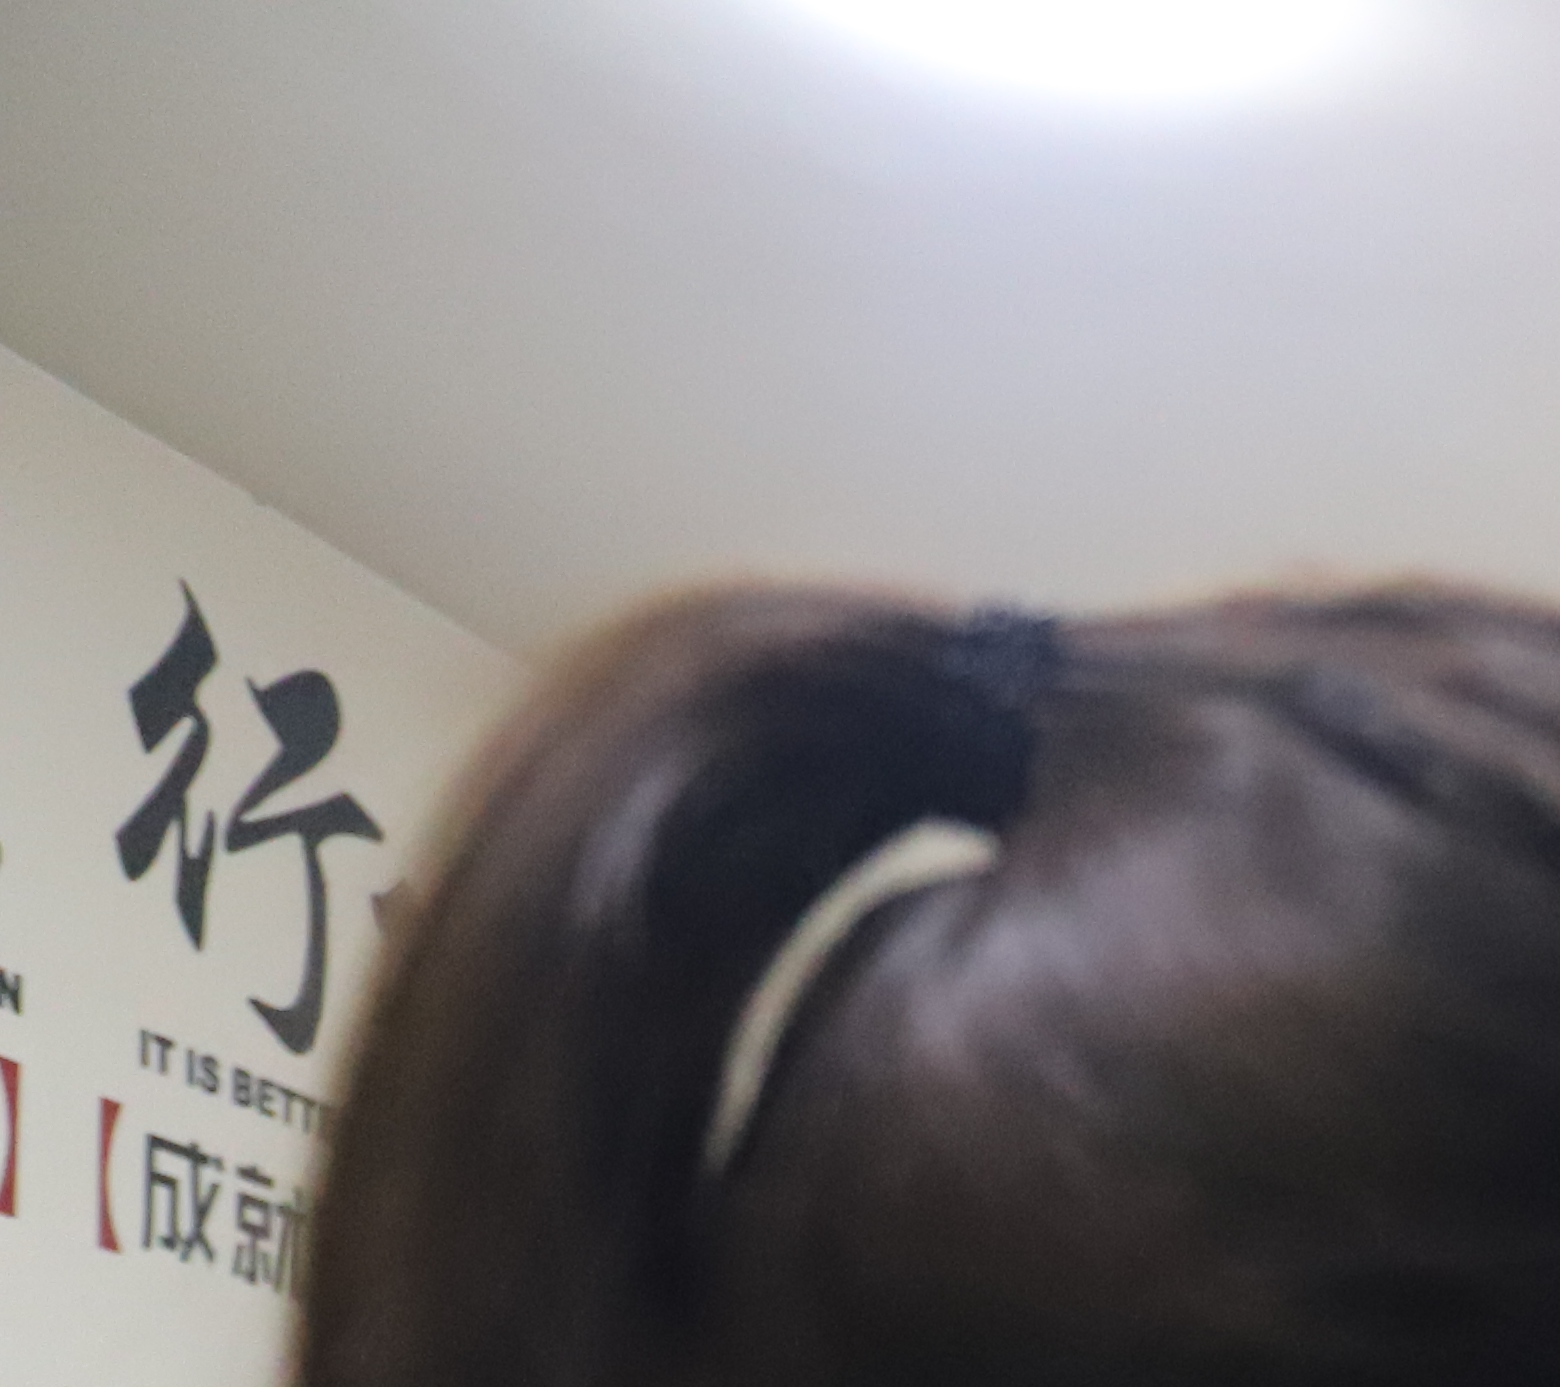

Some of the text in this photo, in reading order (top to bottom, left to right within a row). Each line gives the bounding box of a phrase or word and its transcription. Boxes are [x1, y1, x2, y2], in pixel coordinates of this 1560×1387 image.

[114, 578, 405, 1056] 行
[140, 1029, 331, 1134] IT IS BETT
